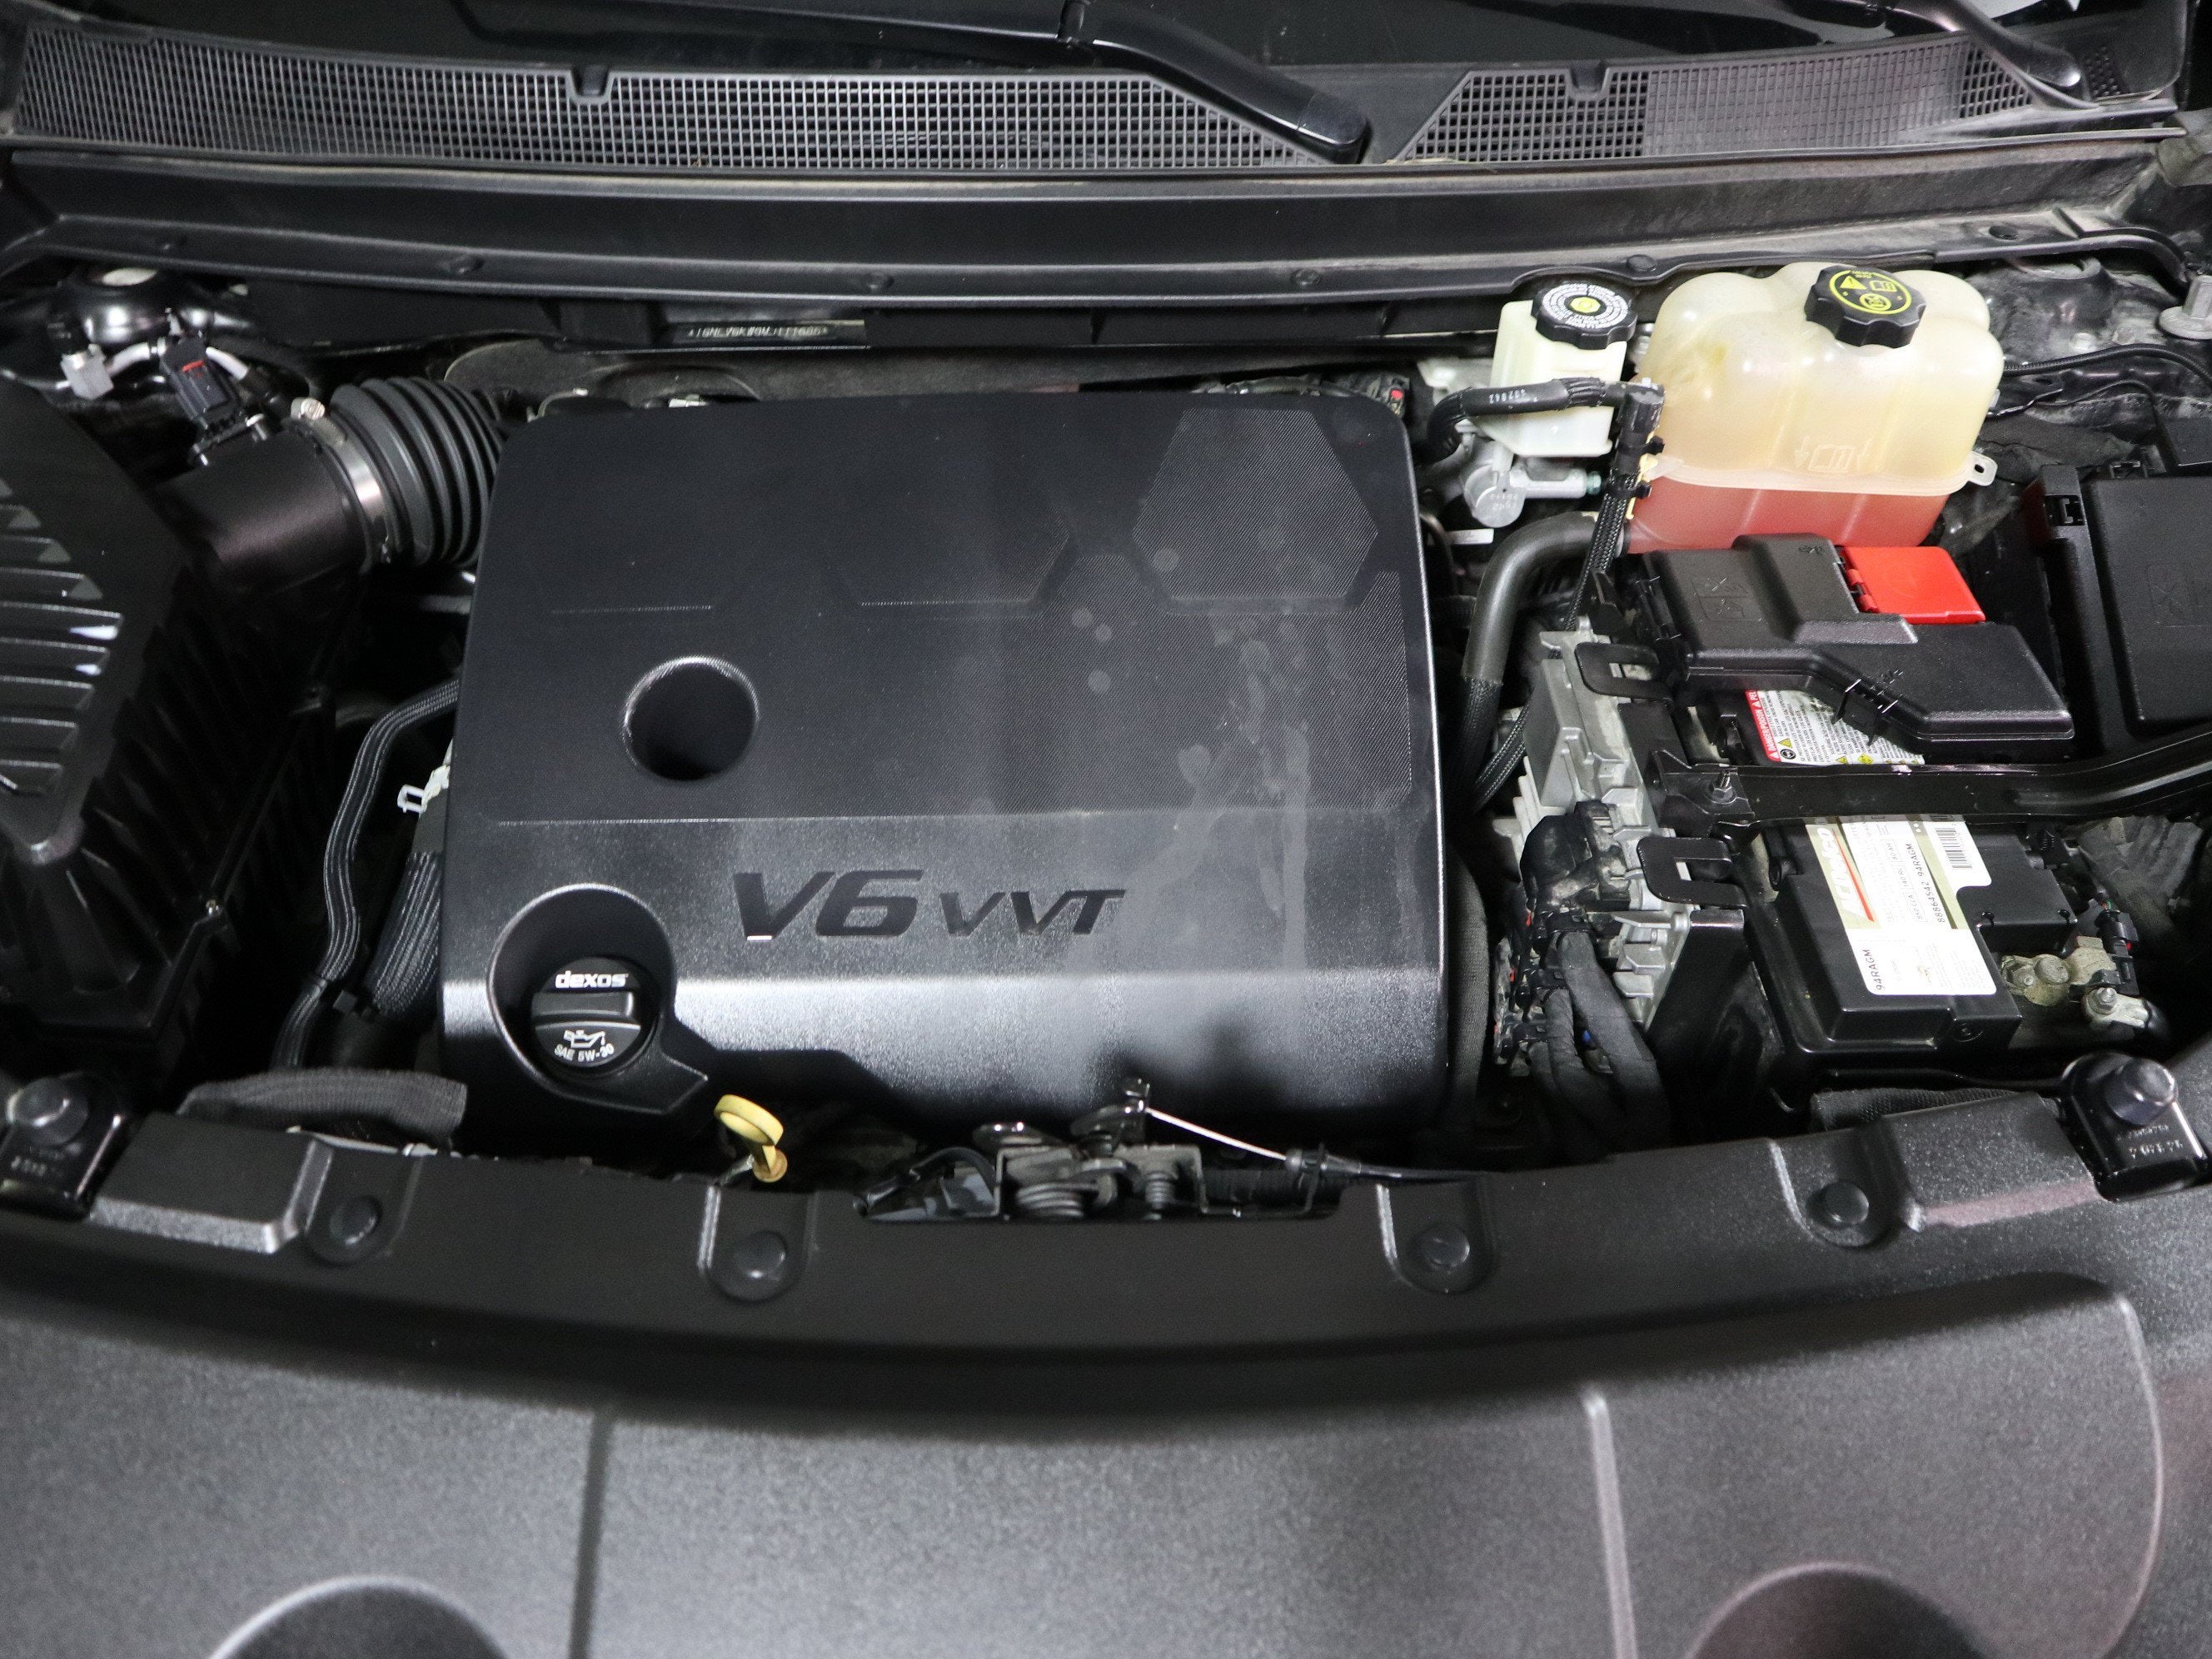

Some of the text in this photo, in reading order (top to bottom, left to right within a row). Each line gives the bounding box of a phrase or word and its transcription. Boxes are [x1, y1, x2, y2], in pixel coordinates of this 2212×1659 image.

[1816, 826, 1866, 918] ACDelco
[1905, 843, 1924, 877] 94RAGM
[732, 869, 1126, 942] V6 VVT
[1921, 880, 1945, 923] 88864542
[555, 970, 628, 989] dexos
[1862, 949, 1883, 990] 94RAGM
[554, 1043, 615, 1062] SAE 5W-30
